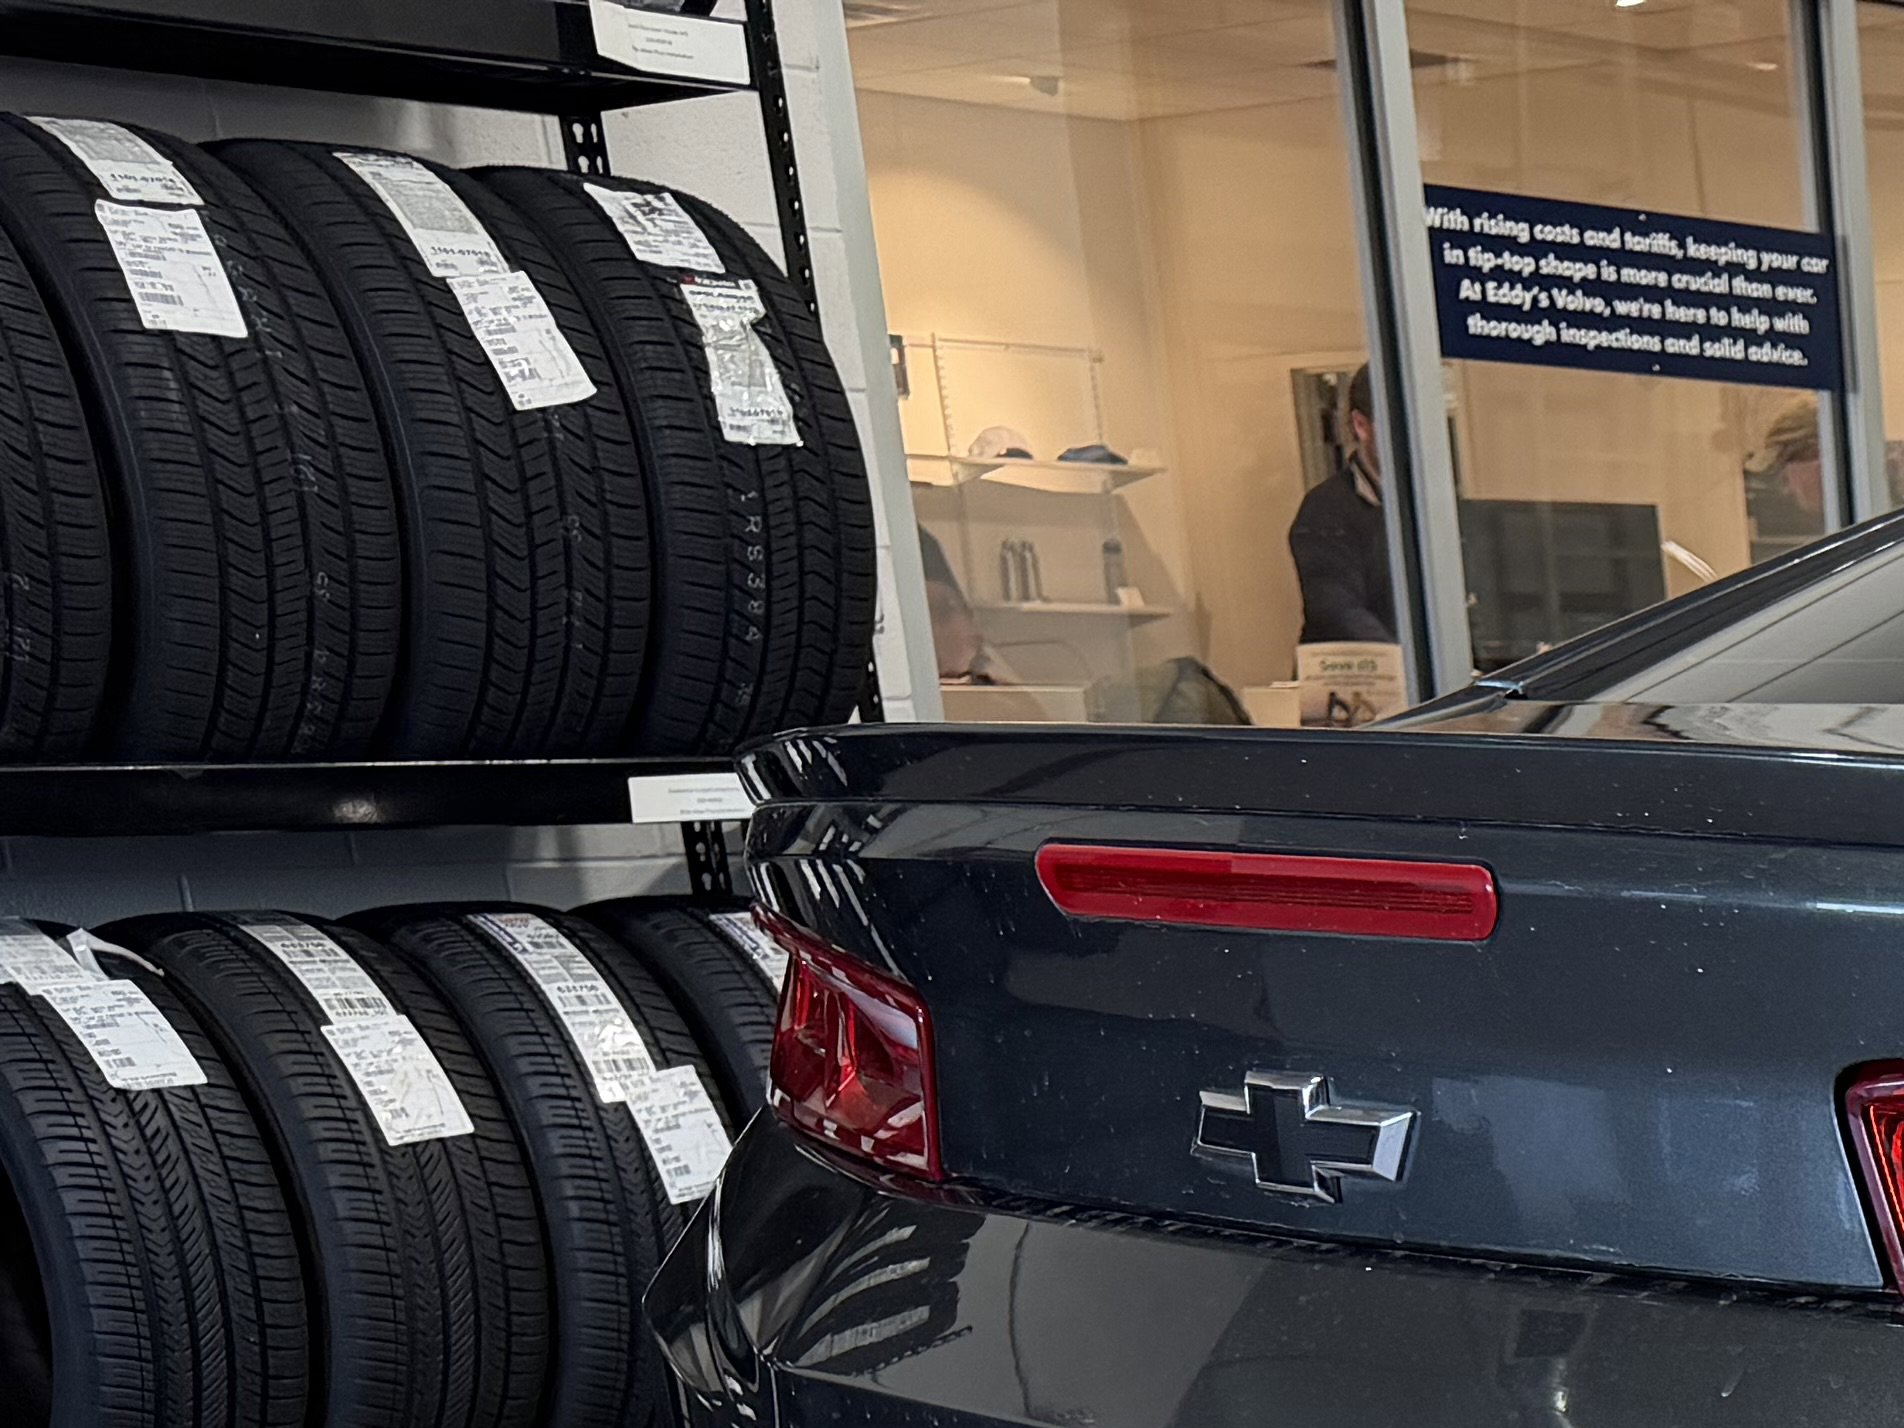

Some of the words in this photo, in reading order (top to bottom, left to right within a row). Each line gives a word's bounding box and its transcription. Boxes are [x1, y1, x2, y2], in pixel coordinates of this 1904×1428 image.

[1425, 206, 1470, 231] With
[1473, 211, 1530, 244] rising
[1533, 223, 1581, 244] costs
[1583, 226, 1621, 249] and
[1623, 231, 1684, 260] tariffs,
[1686, 235, 1758, 270] keeping
[1760, 251, 1799, 272] your
[1801, 256, 1830, 274] car
[1443, 241, 1465, 265] in
[1467, 245, 1536, 278] tip-top
[1538, 252, 1598, 283] shape
[1600, 259, 1618, 282] is
[1620, 266, 1669, 288] more
[1671, 271, 1730, 294] crucial
[1731, 274, 1773, 299] than
[1774, 284, 1818, 304] ever.
[1458, 278, 1482, 301] At
[1485, 281, 1550, 311] Eddy's
[1551, 287, 1611, 318] Volvo,
[1612, 297, 1663, 320] we're
[1664, 298, 1707, 325] here
[1709, 306, 1729, 327] to
[1730, 305, 1771, 336] help
[1772, 312, 1810, 335] with
[1466, 312, 1558, 347] thorough
[1558, 321, 1662, 352] inspections
[1664, 333, 1700, 356] and
[1702, 336, 1746, 360] solid
[1747, 341, 1809, 366] advice.
